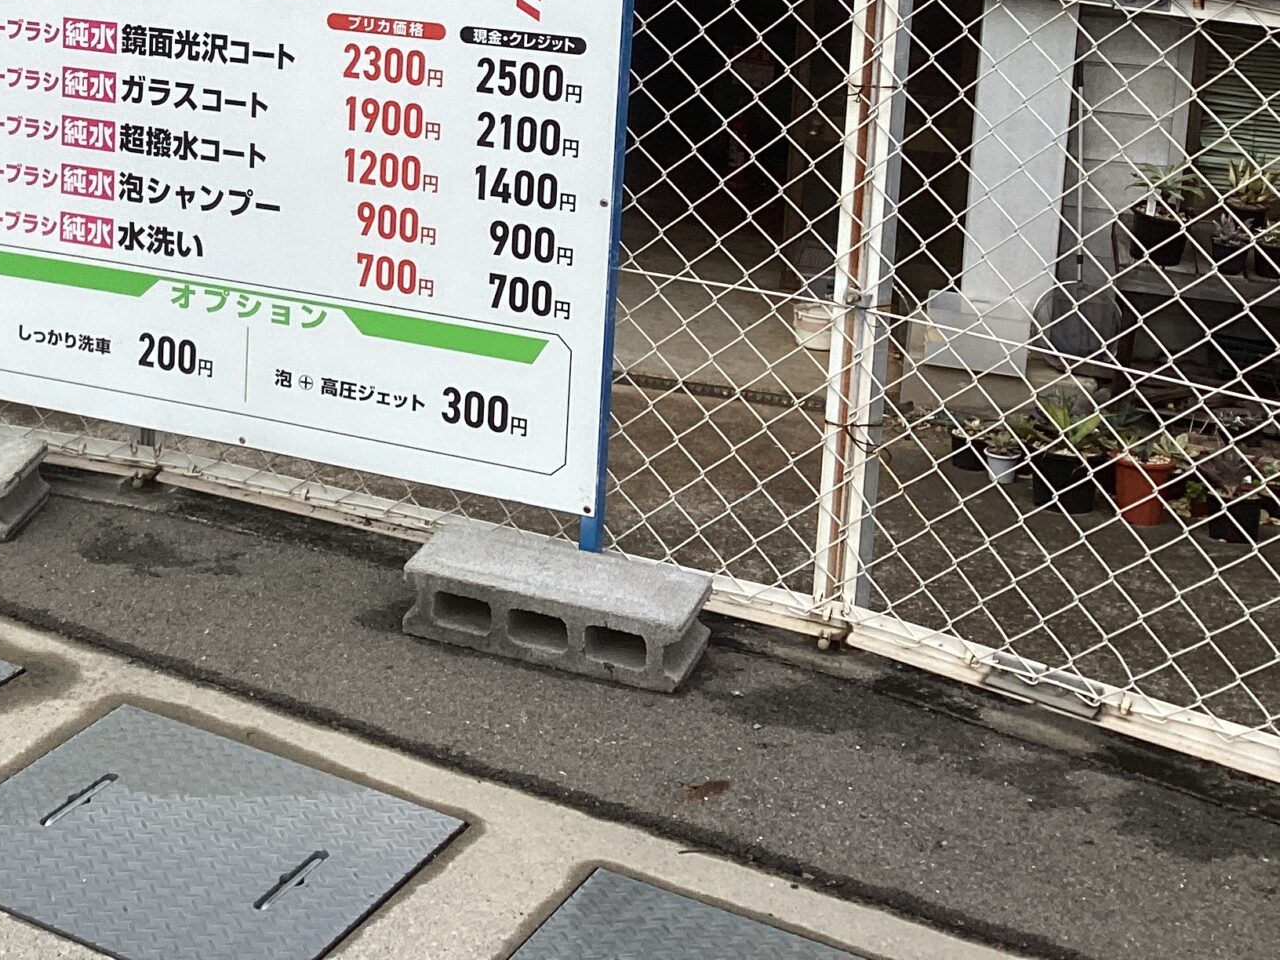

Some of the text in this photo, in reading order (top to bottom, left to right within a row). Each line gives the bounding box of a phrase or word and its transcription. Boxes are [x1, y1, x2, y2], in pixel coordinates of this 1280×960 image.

[64, 18, 117, 52] 純水
[121, 23, 296, 69] 鏡面光沢コート
[472, 28, 575, 52] 現金・クレジット
[343, 43, 443, 87] 2300円
[476, 57, 582, 103] 2500円
[63, 67, 116, 102] 純水
[121, 75, 268, 118] ガラスコート
[346, 96, 441, 140] 1900円
[476, 111, 579, 158] 2100円
[62, 116, 115, 151] 純水
[119, 123, 267, 168] 超撥水コート
[62, 165, 114, 199] 純水
[119, 172, 281, 216] 泡シャンプー
[344, 148, 439, 193] 1200円
[475, 164, 577, 212] 1400円
[61, 213, 113, 247] 純水
[118, 222, 204, 257] 水洗い
[357, 201, 436, 245] 900円
[489, 220, 574, 266] 900円
[356, 252, 434, 297] 700円
[488, 272, 571, 320] 700円
[170, 284, 327, 329] オプション
[18, 324, 112, 355] しっかり洗車
[138, 332, 213, 378] 200円
[440, 386, 528, 436] 300円
